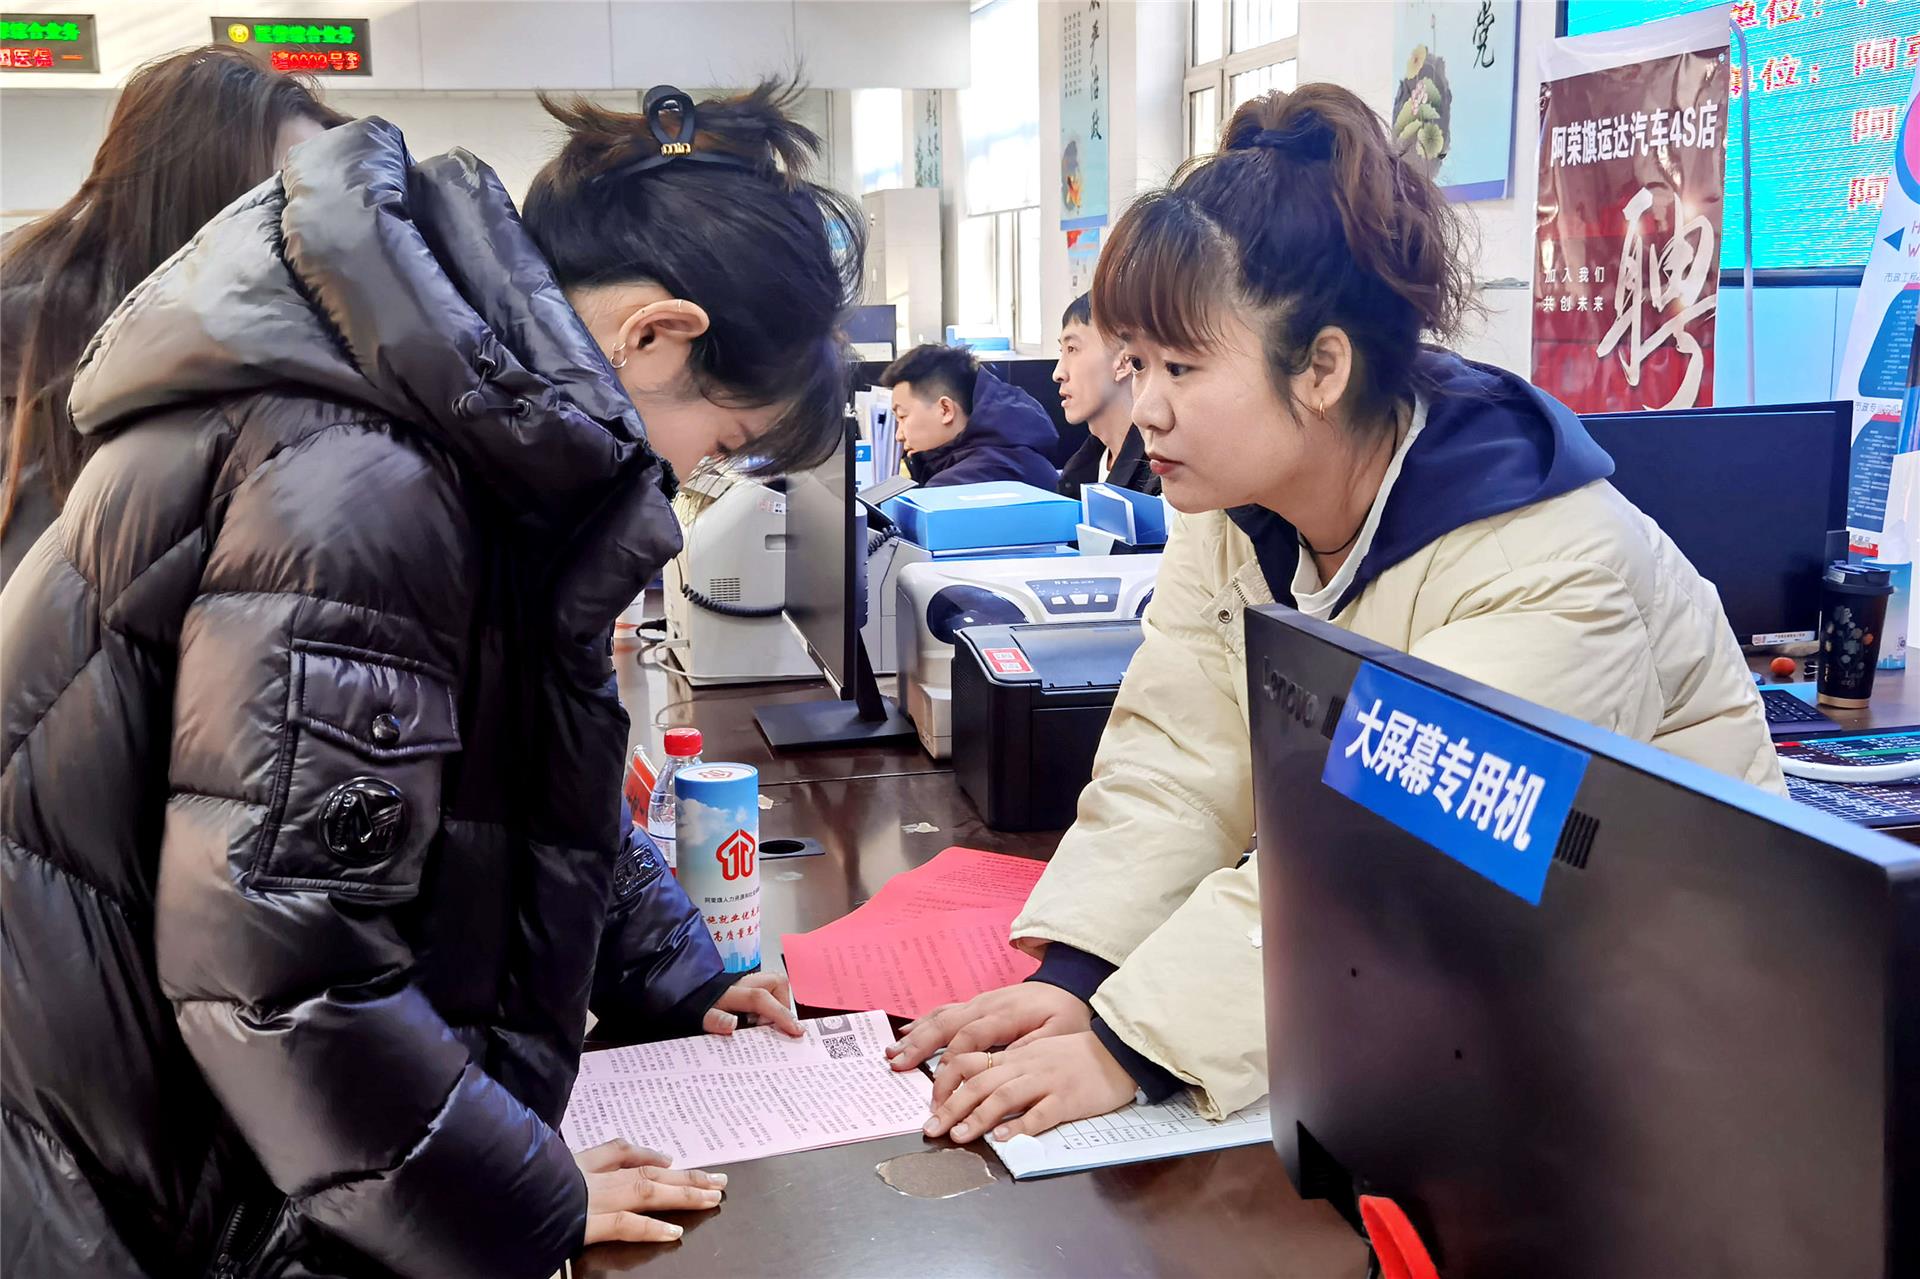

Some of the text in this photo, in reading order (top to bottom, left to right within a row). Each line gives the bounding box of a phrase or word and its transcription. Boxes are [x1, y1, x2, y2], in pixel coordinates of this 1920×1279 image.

[1551, 99, 1718, 168] 阿荣旗运达汽车4S店
[1543, 266, 1605, 284] 加入我们
[1542, 295, 1604, 312] 共创未来
[1344, 698, 1547, 852] 大屏幕专用机
